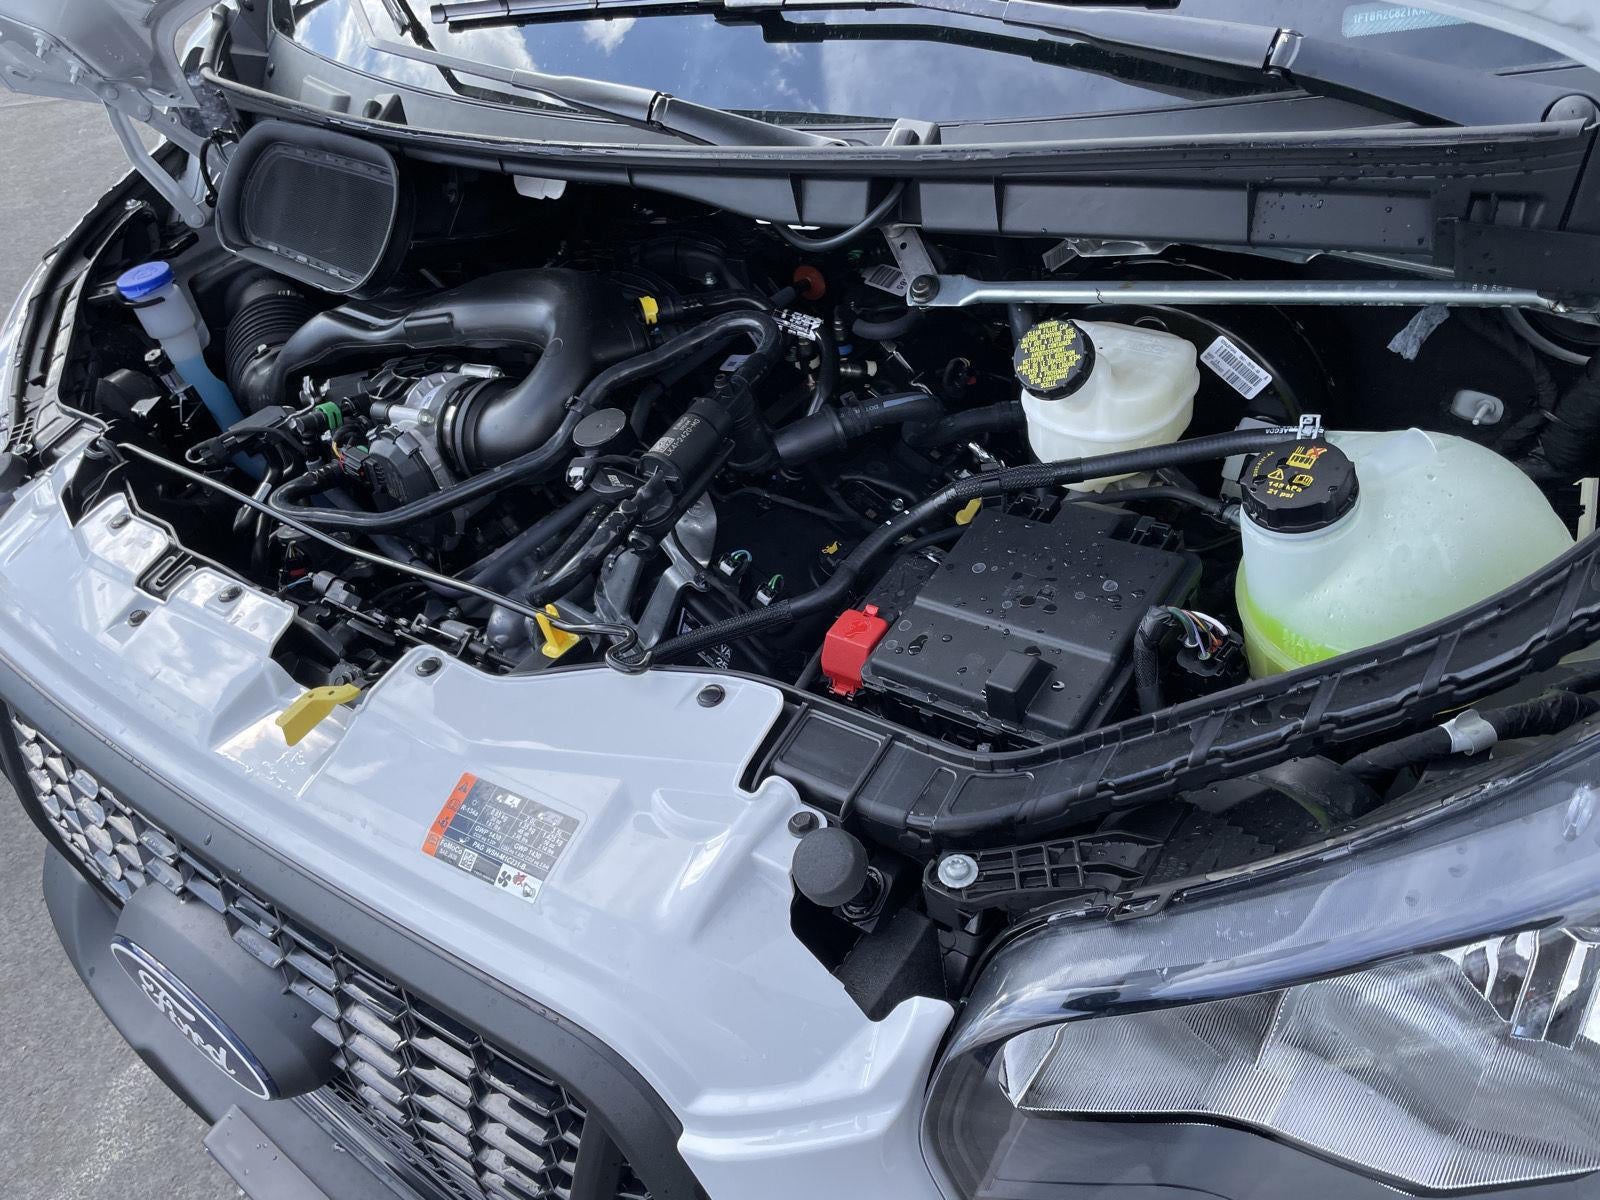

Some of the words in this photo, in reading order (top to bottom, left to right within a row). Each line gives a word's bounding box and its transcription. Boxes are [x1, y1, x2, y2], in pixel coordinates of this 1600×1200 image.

[460, 804, 479, 816] R-134a
[474, 825, 488, 835] GWP
[488, 831, 501, 841] 1430
[439, 839, 463, 854] FoMoCo
[472, 840, 484, 850] PAG
[513, 842, 528, 852] GWP
[528, 849, 542, 859] 1430
